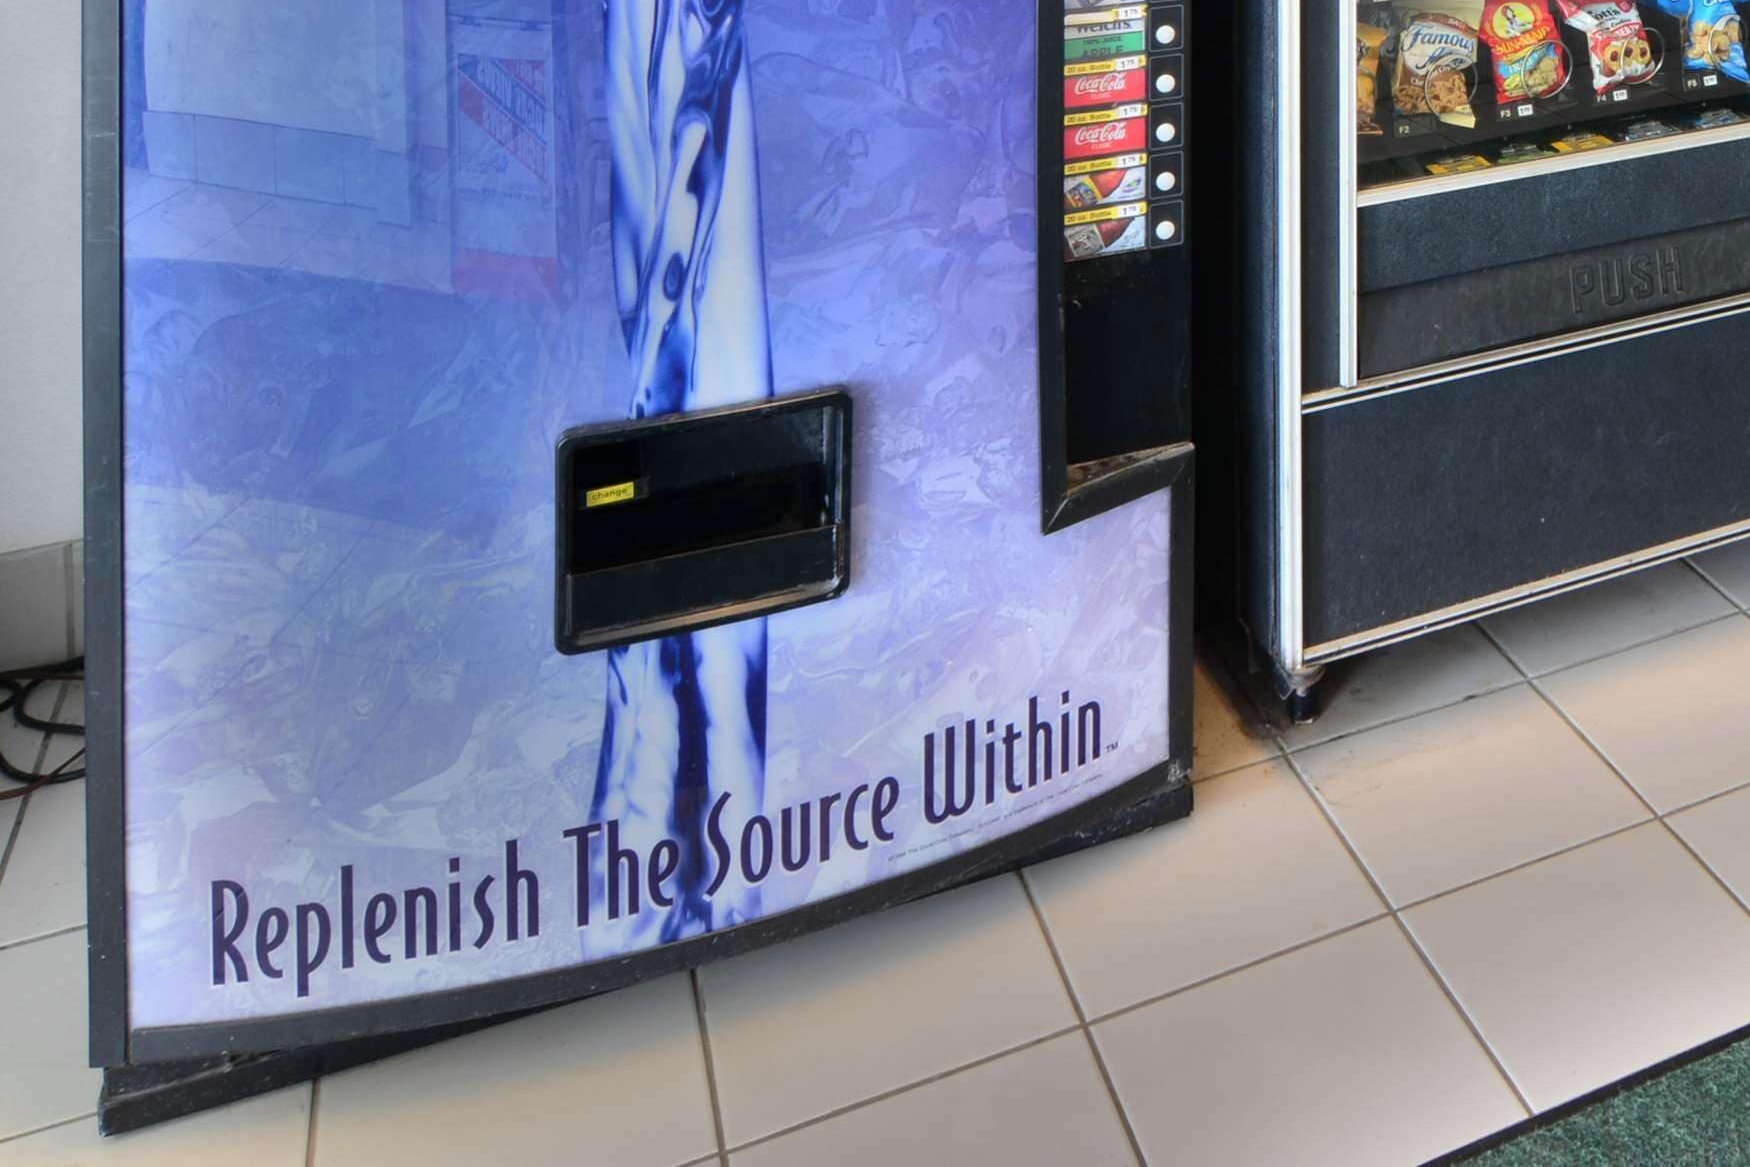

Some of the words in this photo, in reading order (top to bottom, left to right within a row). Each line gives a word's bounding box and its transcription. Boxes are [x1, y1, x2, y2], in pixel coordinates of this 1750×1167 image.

[1402, 23, 1475, 53] Famous
[1075, 72, 1128, 95] Coca-Cola
[1075, 121, 1128, 146] Coca-Cola
[1569, 245, 1685, 314] PUSH
[591, 486, 628, 502] change
[211, 838, 541, 997] Replenish
[562, 823, 679, 928] The
[703, 775, 901, 901] Source
[921, 690, 1105, 825] Within
